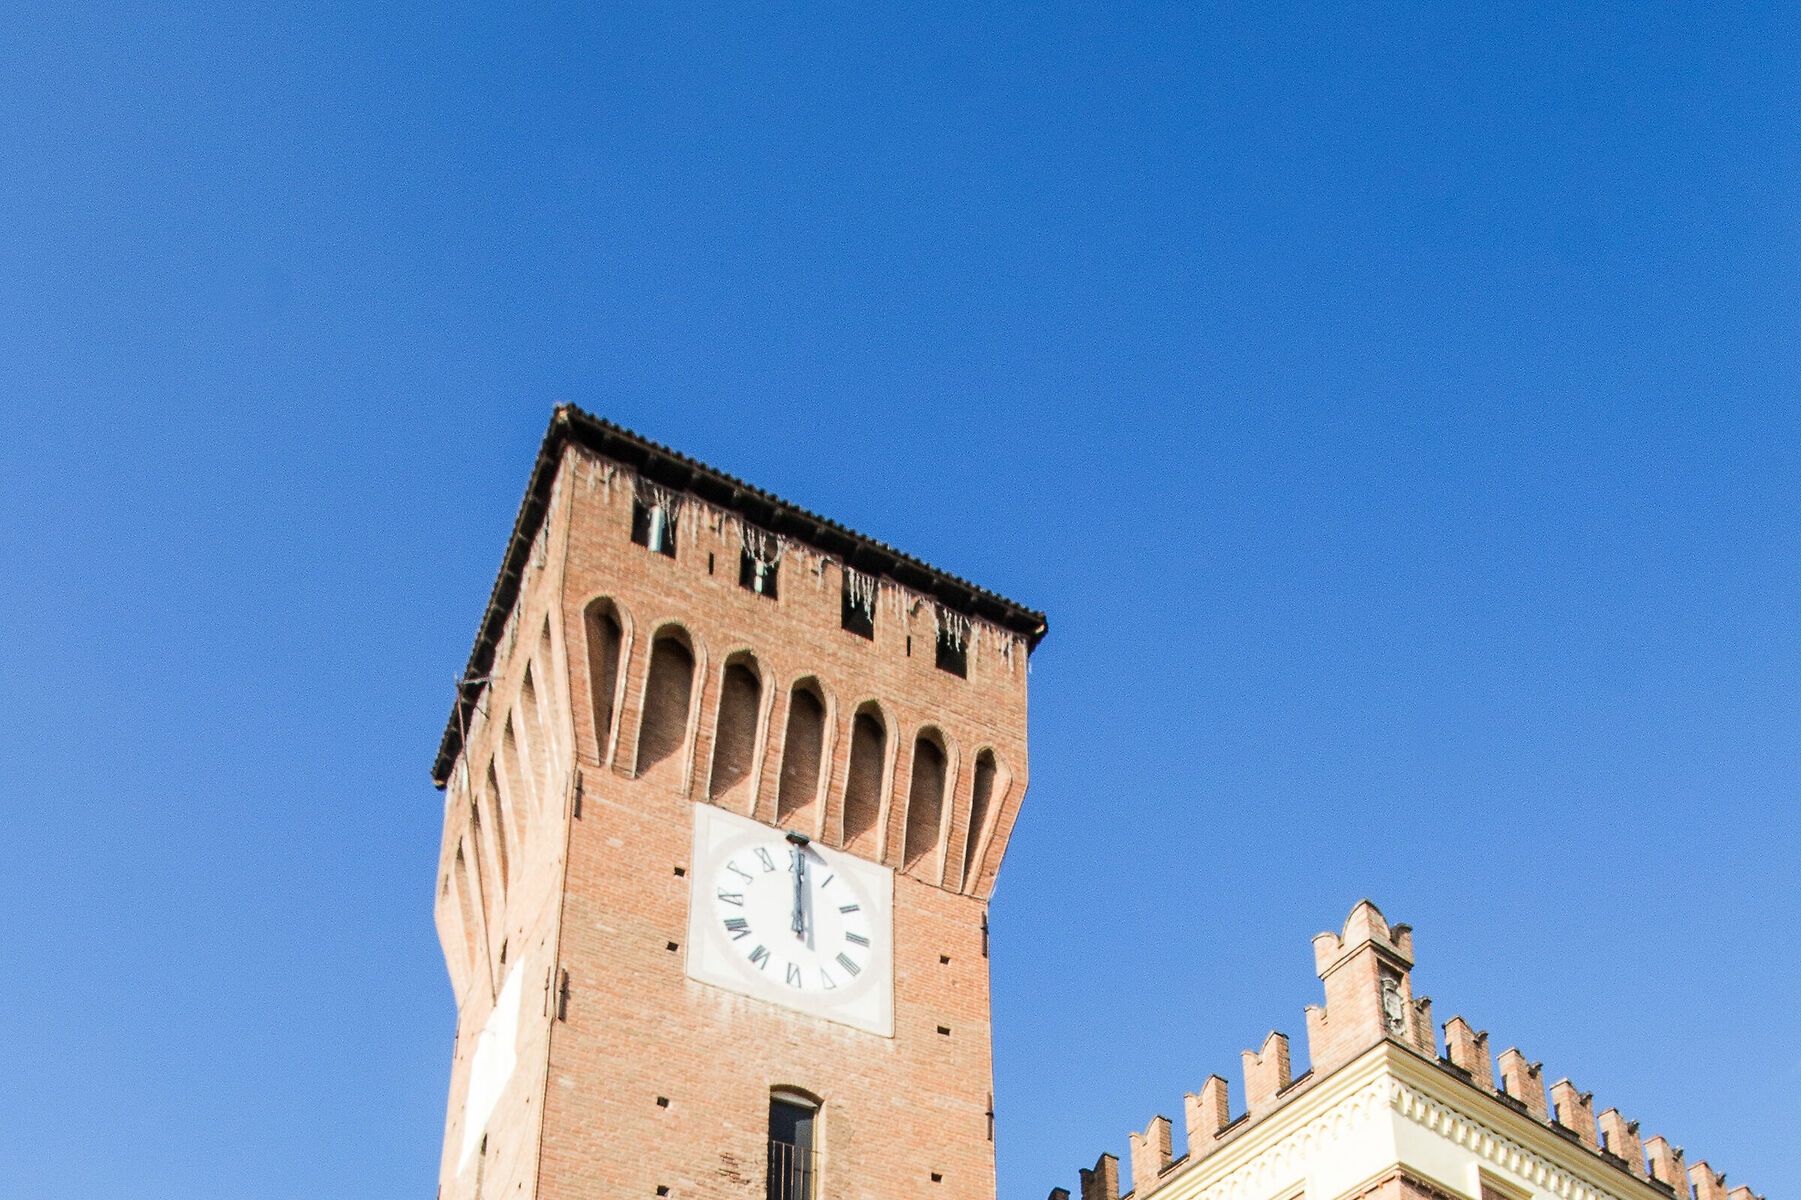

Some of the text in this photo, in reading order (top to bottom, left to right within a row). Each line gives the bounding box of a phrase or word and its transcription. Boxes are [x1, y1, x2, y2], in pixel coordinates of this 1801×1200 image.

[726, 860, 754, 886] X
[821, 874, 835, 889] I
[838, 904, 861, 915] II
[845, 931, 871, 948] III
[820, 966, 837, 990] V
